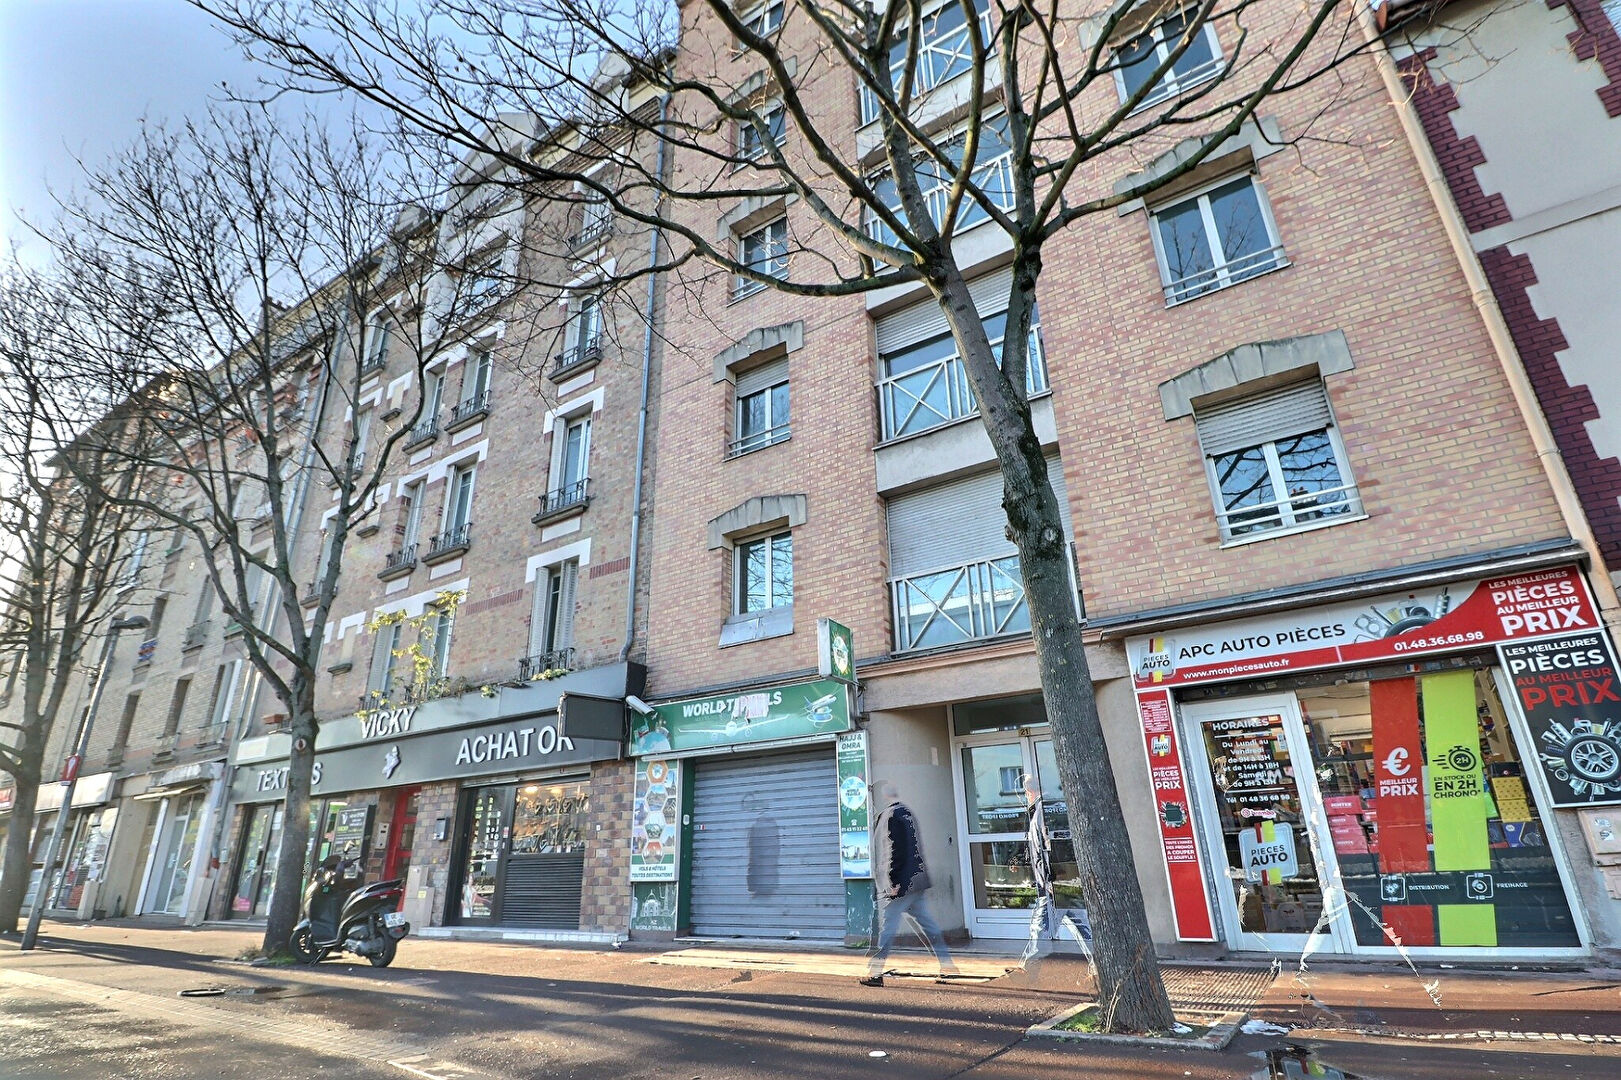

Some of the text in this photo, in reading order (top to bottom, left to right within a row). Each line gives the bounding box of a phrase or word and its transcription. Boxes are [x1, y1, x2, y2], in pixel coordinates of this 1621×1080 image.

[1489, 570, 1568, 590] LES MEILLEURES
[1491, 580, 1575, 606] PIÈCES
[1497, 596, 1580, 616] AU MEILLEUR
[1500, 605, 1588, 636] PRIX
[1178, 624, 1346, 660] APC AUTO PIÈCES
[1394, 631, 1484, 652] 01.48.36.68.98
[1505, 637, 1599, 657] LES MEILLEURES
[1142, 659, 1170, 670] AUTO
[1144, 654, 1169, 662] PIECES
[1510, 649, 1605, 675] PIÈCES
[1183, 658, 1290, 680] www.monpiecesauto.fr
[1516, 666, 1613, 687] AU MEILLEUR
[1520, 678, 1621, 712] PRIX
[360, 706, 418, 739] VICKY
[1212, 718, 1270, 731] HORAIRES
[455, 727, 536, 766] ACHAT
[841, 742, 861, 750] OMRA
[1236, 739, 1257, 747] Lundi
[1456, 756, 1470, 764] 2H
[1155, 780, 1182, 790] PRIX
[1380, 778, 1418, 786] MEILLEUR
[1380, 785, 1419, 798] PRIX
[1435, 780, 1476, 791] EN 2H
[1251, 844, 1285, 856] PIECES
[1251, 852, 1288, 867] AUTO
